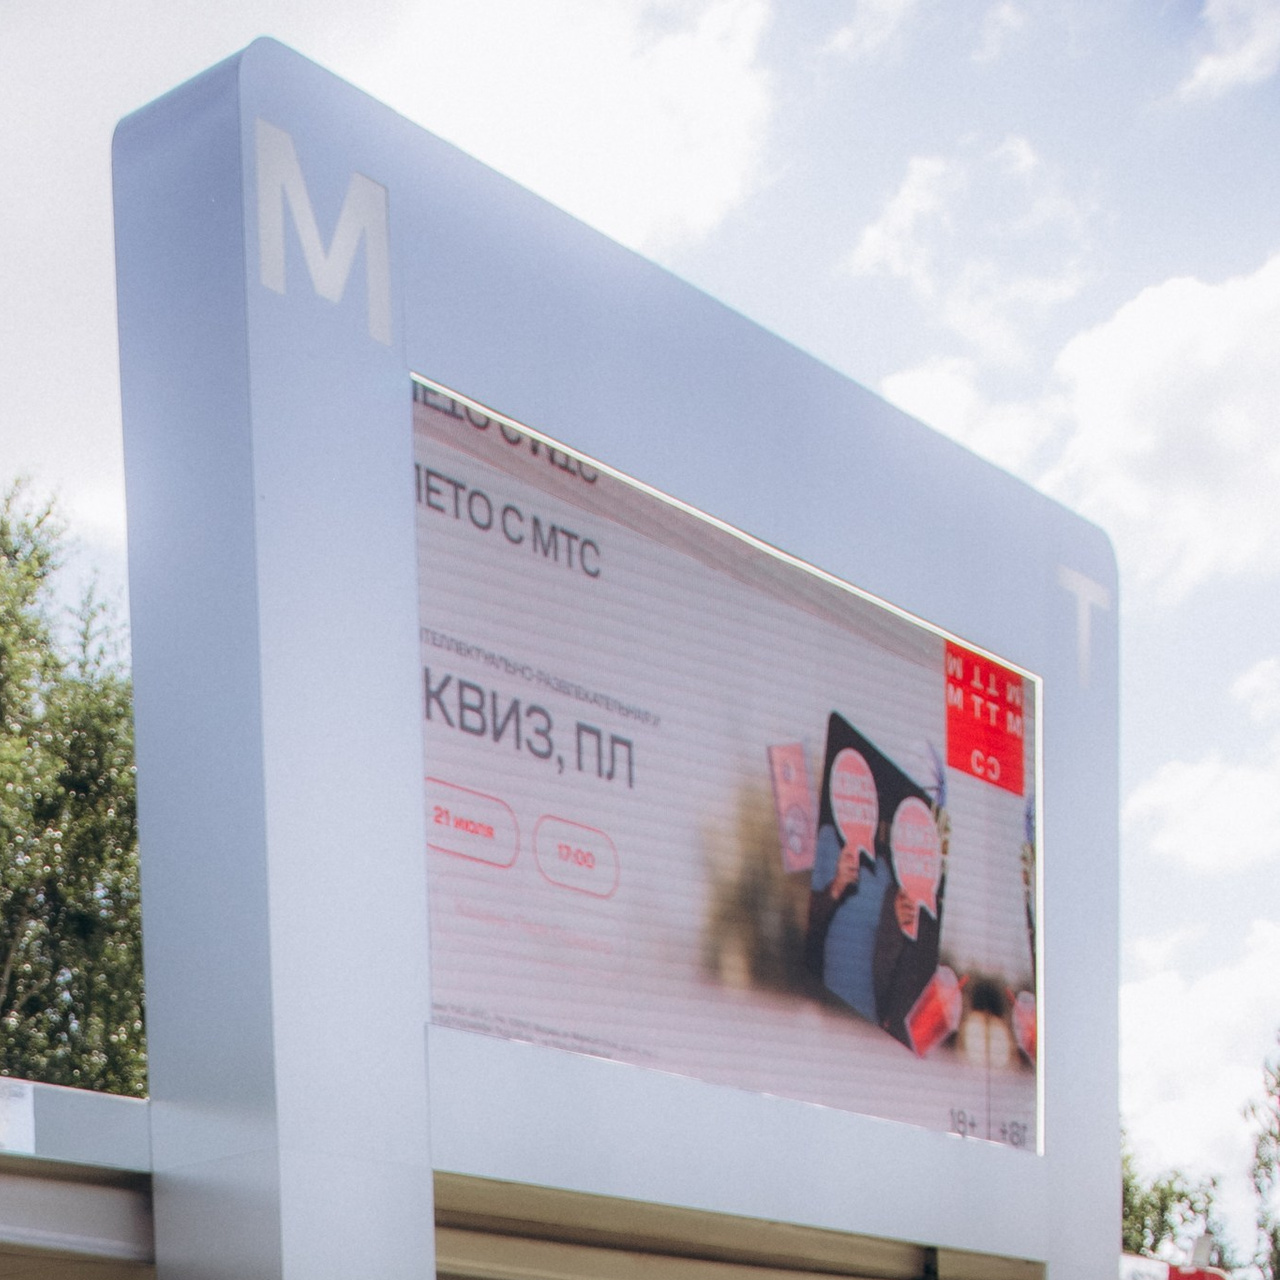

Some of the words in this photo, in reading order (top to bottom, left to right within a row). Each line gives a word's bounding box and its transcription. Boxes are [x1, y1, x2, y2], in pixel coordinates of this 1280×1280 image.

[254, 115, 393, 347] М
[501, 504, 524, 545] С
[532, 515, 600, 578] МТС
[1054, 563, 1111, 691] Т
[424, 665, 564, 775] КВИЗ,
[576, 720, 634, 788] ПЛ
[433, 805, 450, 827] 21
